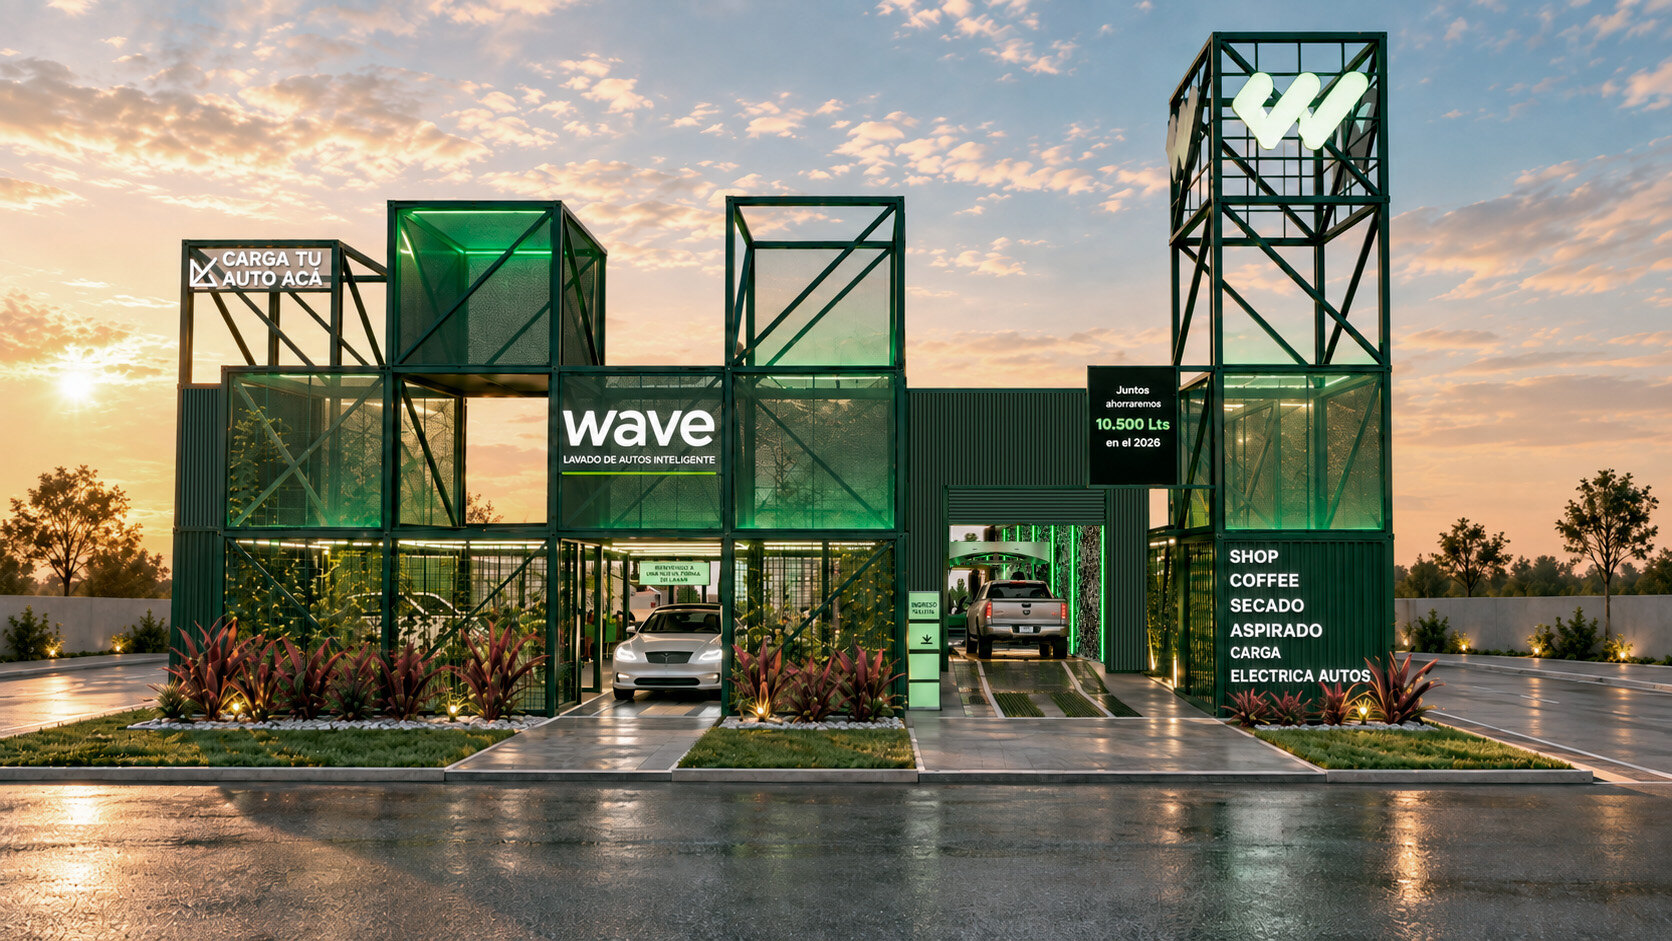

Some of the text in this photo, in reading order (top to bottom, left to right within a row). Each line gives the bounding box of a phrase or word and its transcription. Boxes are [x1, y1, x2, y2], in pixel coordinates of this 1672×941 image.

[222, 251, 322, 268] CARGA TU
[222, 267, 323, 287] AUTO ACÁ
[1116, 385, 1150, 395] Juntos
[1105, 399, 1162, 408] ahorraremos
[563, 410, 714, 446] wave
[1095, 417, 1170, 431] 10.500 Lts
[1105, 437, 1161, 448] en el 2026
[563, 455, 716, 464] LAVADO DE AUTOS INTELIGENTE
[1229, 549, 1279, 564] SHOP
[1229, 573, 1300, 588] COFFEE
[1230, 598, 1305, 613] SECADO
[1230, 622, 1323, 638] ASPIRADO
[1230, 646, 1282, 659] CARGA
[1230, 669, 1371, 683] ELECTRICA AUTOS
